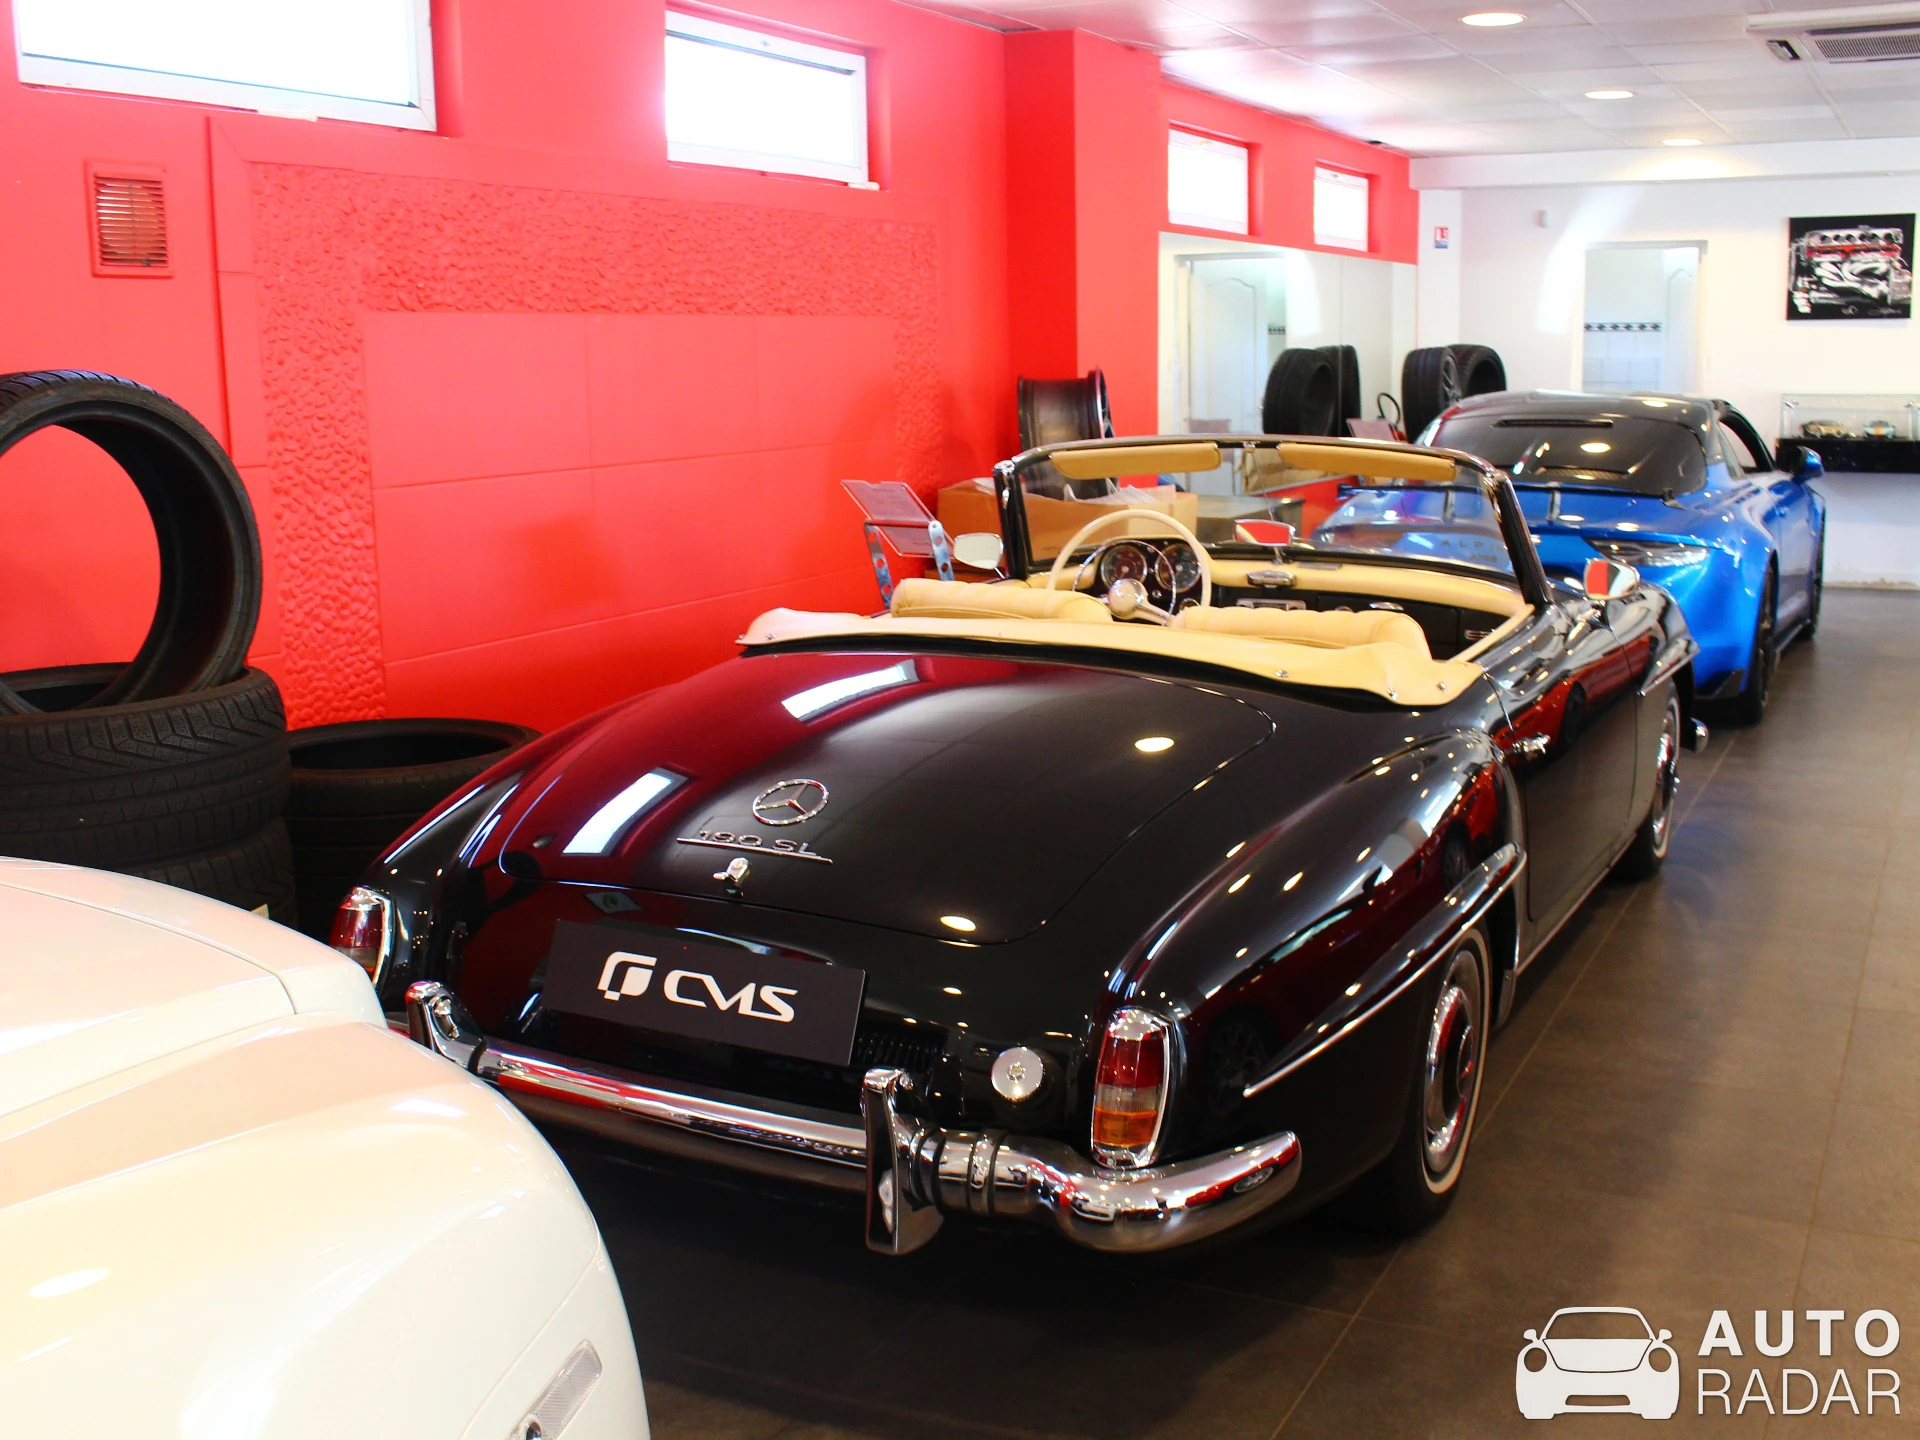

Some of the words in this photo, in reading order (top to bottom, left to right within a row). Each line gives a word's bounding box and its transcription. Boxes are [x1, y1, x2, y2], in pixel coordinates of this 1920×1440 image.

[1441, 539, 1505, 553] ALPIN
[699, 829, 763, 847] 190
[772, 837, 817, 856] SL
[663, 969, 798, 1023] CMS
